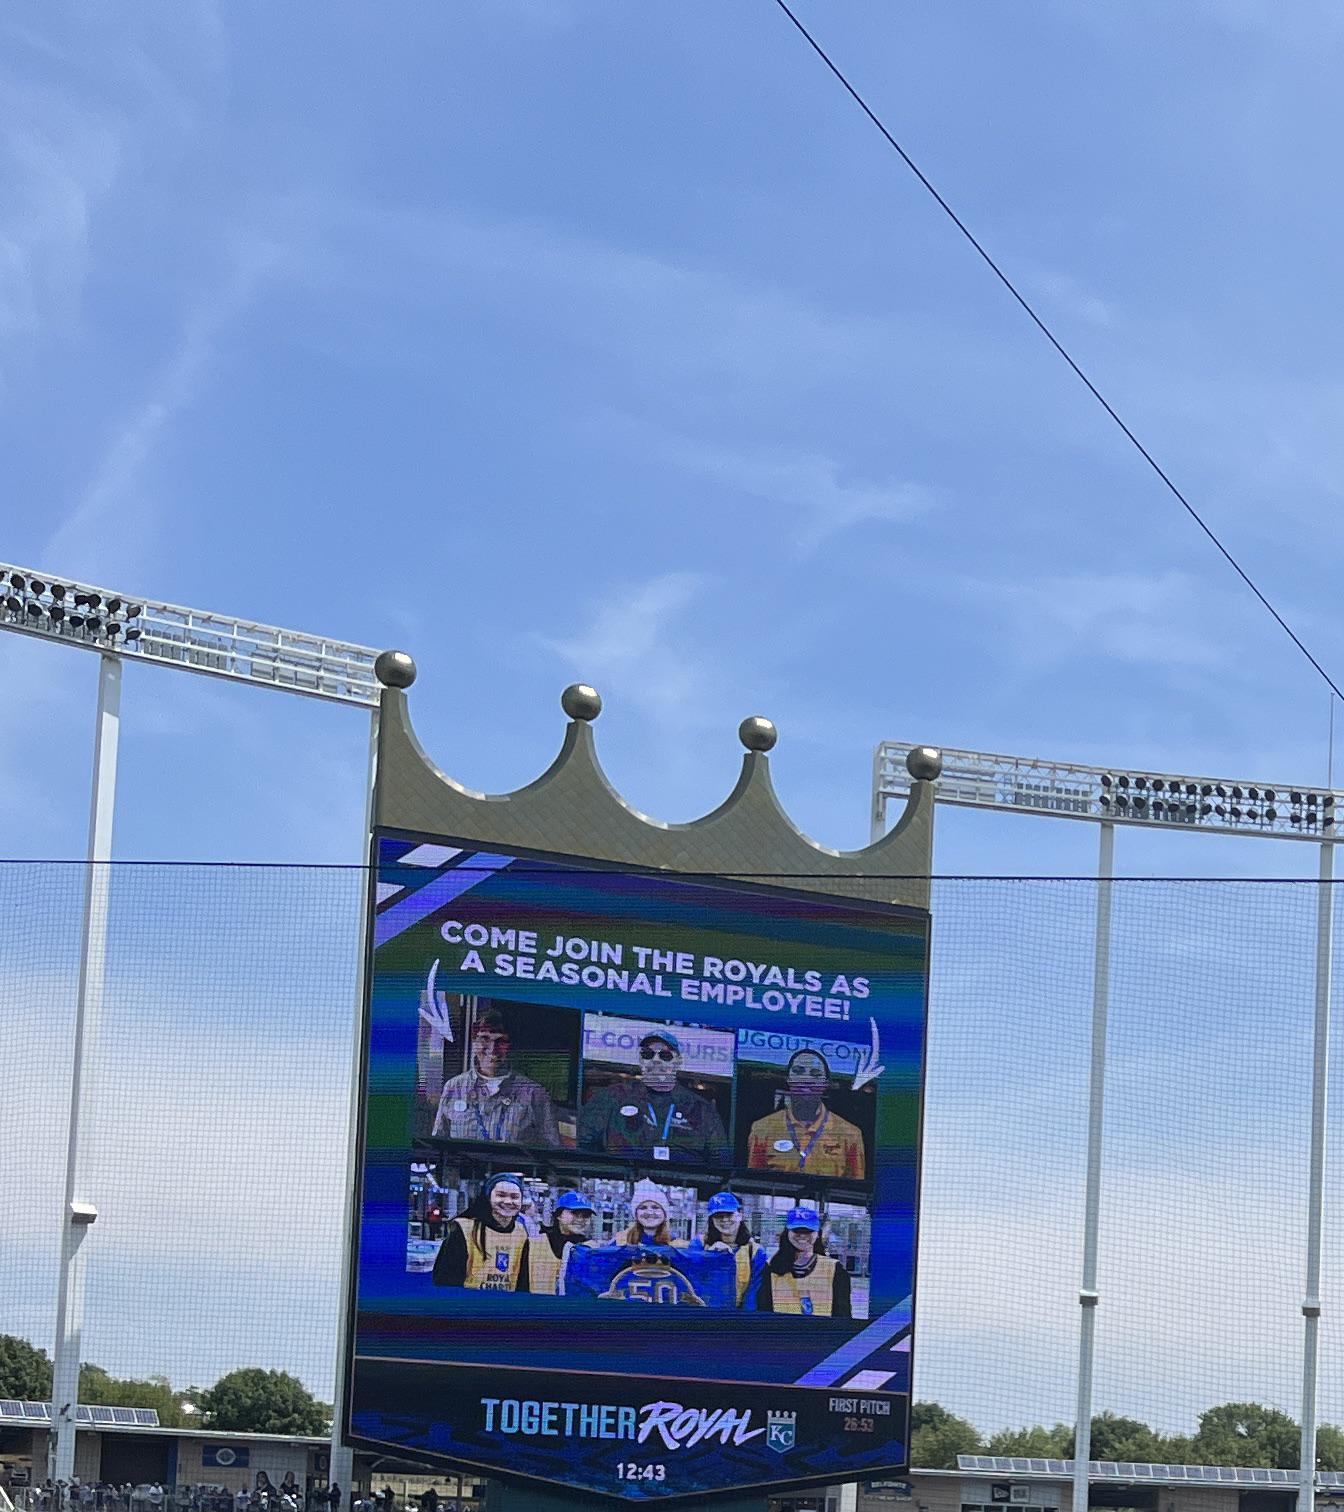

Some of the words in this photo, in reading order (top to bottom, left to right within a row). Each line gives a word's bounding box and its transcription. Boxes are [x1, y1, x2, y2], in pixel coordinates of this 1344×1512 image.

[440, 920, 538, 955] COME
[547, 936, 623, 966] JOIN
[632, 946, 694, 975] THE
[703, 956, 822, 994] ROYALS
[830, 974, 871, 999] AS
[460, 949, 485, 973] A
[494, 954, 672, 998] SEASONAL
[680, 979, 851, 1021] EMPLOYEE!
[480, 1398, 636, 1439] TOGETHER
[638, 1400, 766, 1450] ROYAL
[828, 1397, 858, 1415] FIRST
[860, 1399, 891, 1416] PITCH
[769, 1425, 793, 1447] KC
[616, 1462, 666, 1481] 12:43
